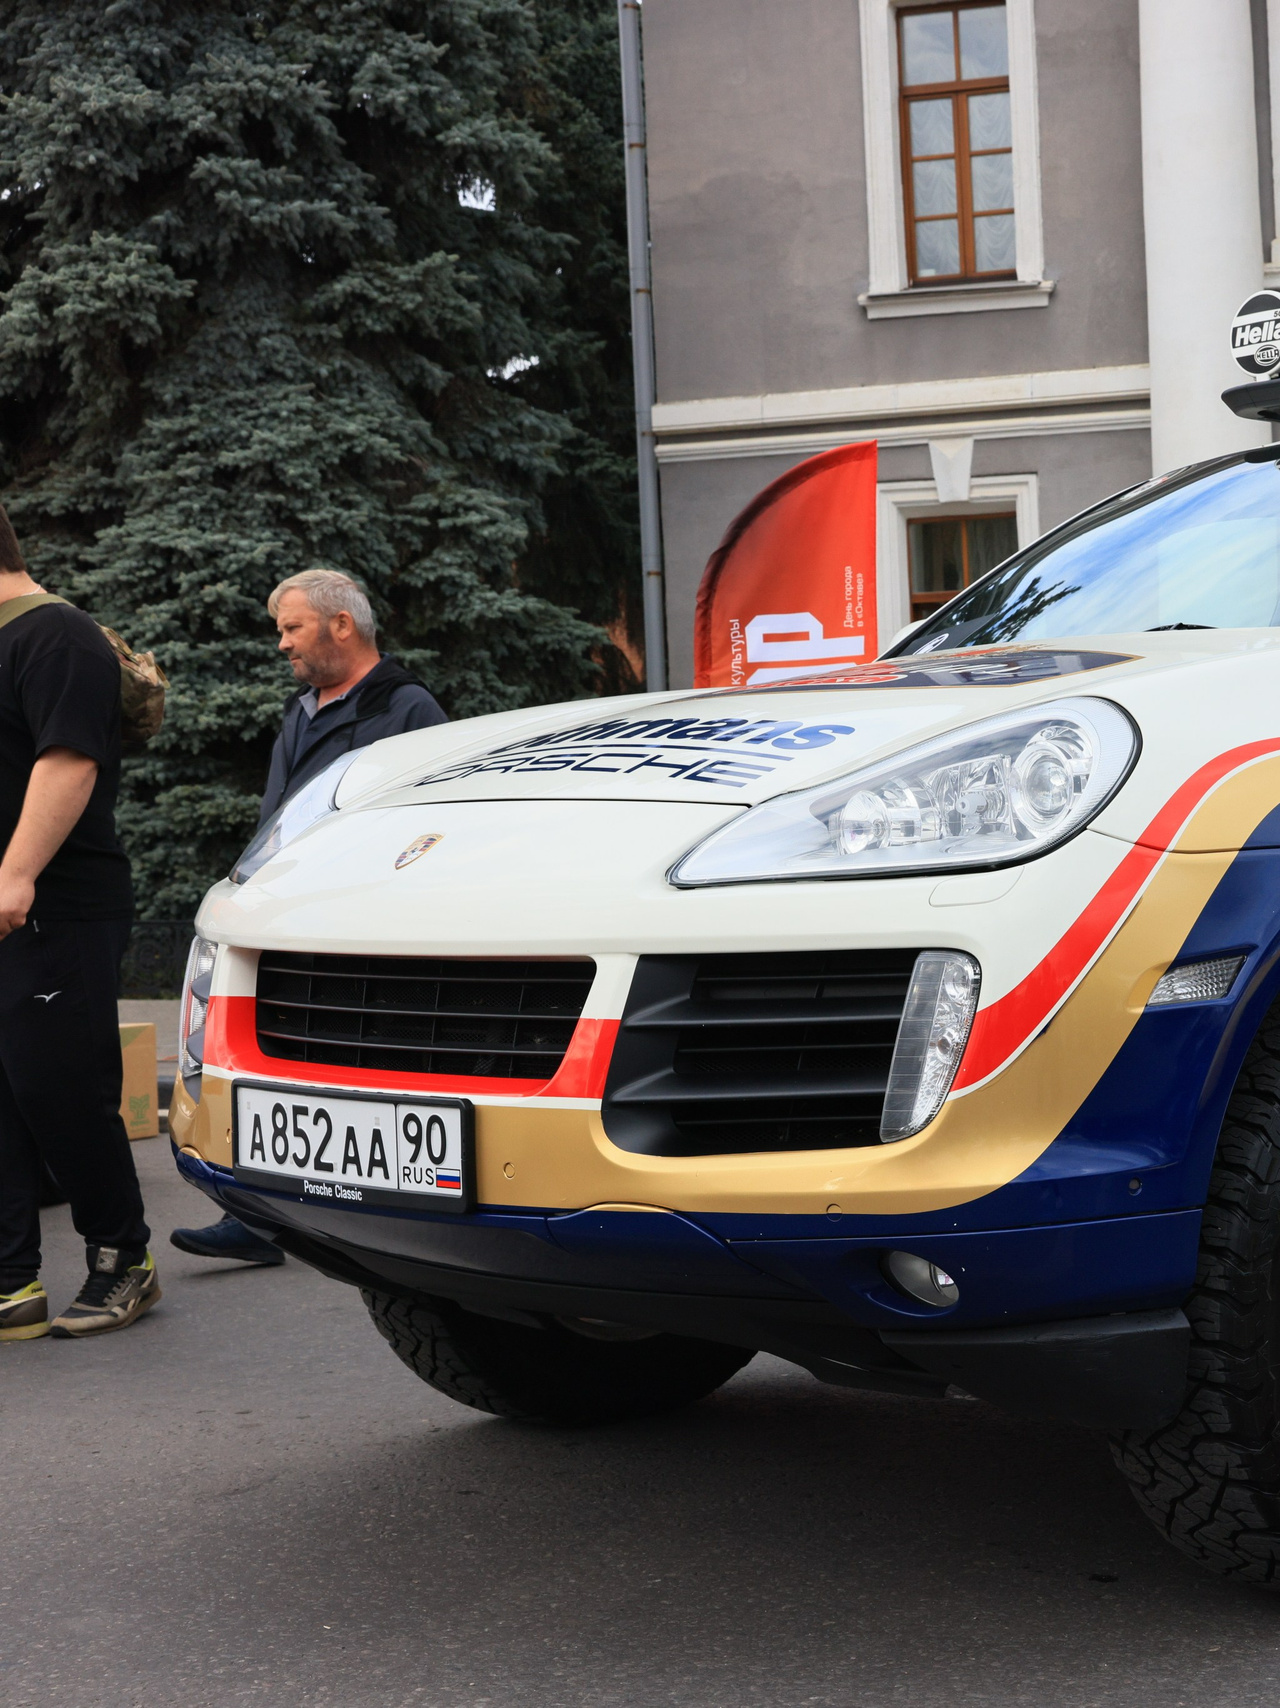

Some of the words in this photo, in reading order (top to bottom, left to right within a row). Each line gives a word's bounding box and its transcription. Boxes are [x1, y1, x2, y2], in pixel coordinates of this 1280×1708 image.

[844, 566, 854, 600] города
[855, 573, 864, 618] «Октаве»
[844, 602, 853, 628] День
[730, 618, 746, 685] культуры
[486, 716, 856, 756] othmans
[414, 752, 775, 788] ORSCHE
[250, 1102, 390, 1180] А852АА
[402, 1112, 447, 1165] 90
[304, 1180, 333, 1198] Porsche
[334, 1184, 362, 1202] Classic
[402, 1166, 435, 1186] RUS
